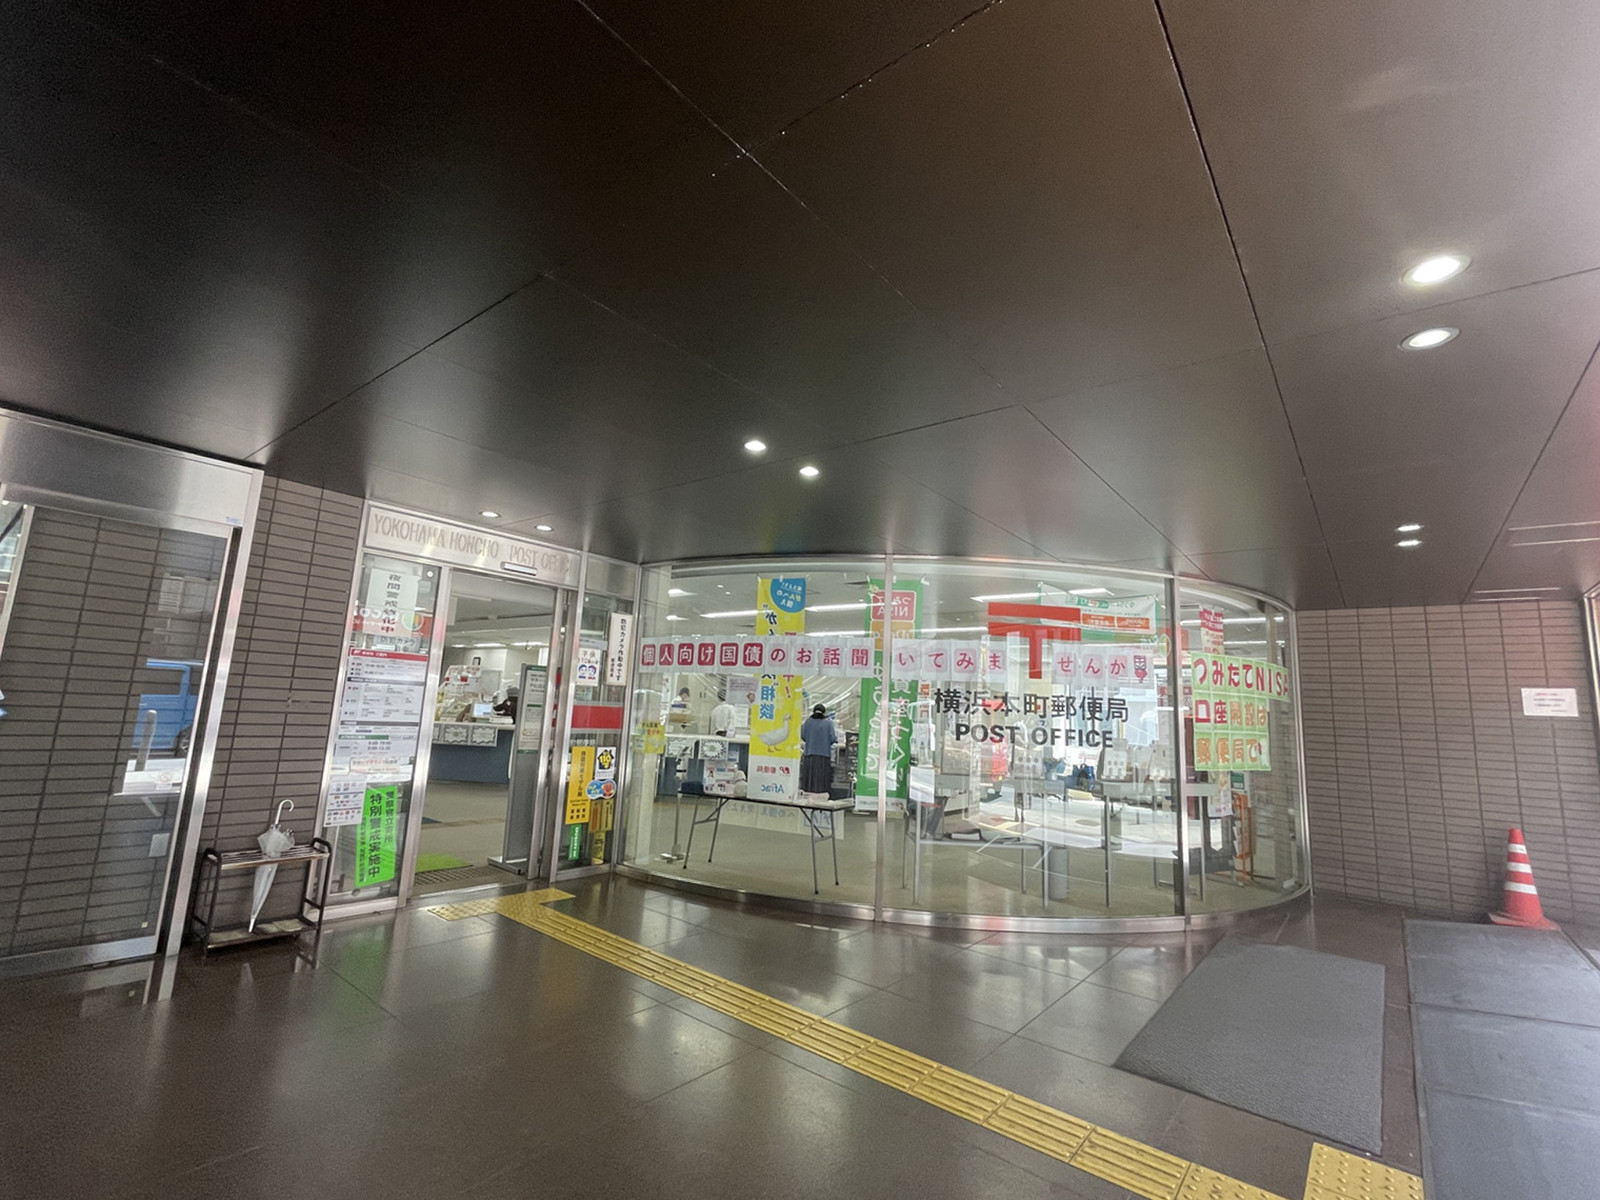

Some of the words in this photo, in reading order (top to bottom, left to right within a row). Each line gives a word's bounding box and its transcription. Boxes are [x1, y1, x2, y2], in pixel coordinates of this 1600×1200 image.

[373, 513, 445, 548] YOKOHAMA
[450, 532, 499, 559] HONCHO
[510, 545, 538, 567] POST
[1193, 658, 1289, 697] つみたてNISA
[934, 687, 1129, 723] 横浜本町郵便局
[1194, 699, 1267, 727] 口座開設は
[955, 723, 1020, 744] POST
[1031, 727, 1113, 748] OFFICE
[368, 793, 382, 878] 特別警戒実施中
